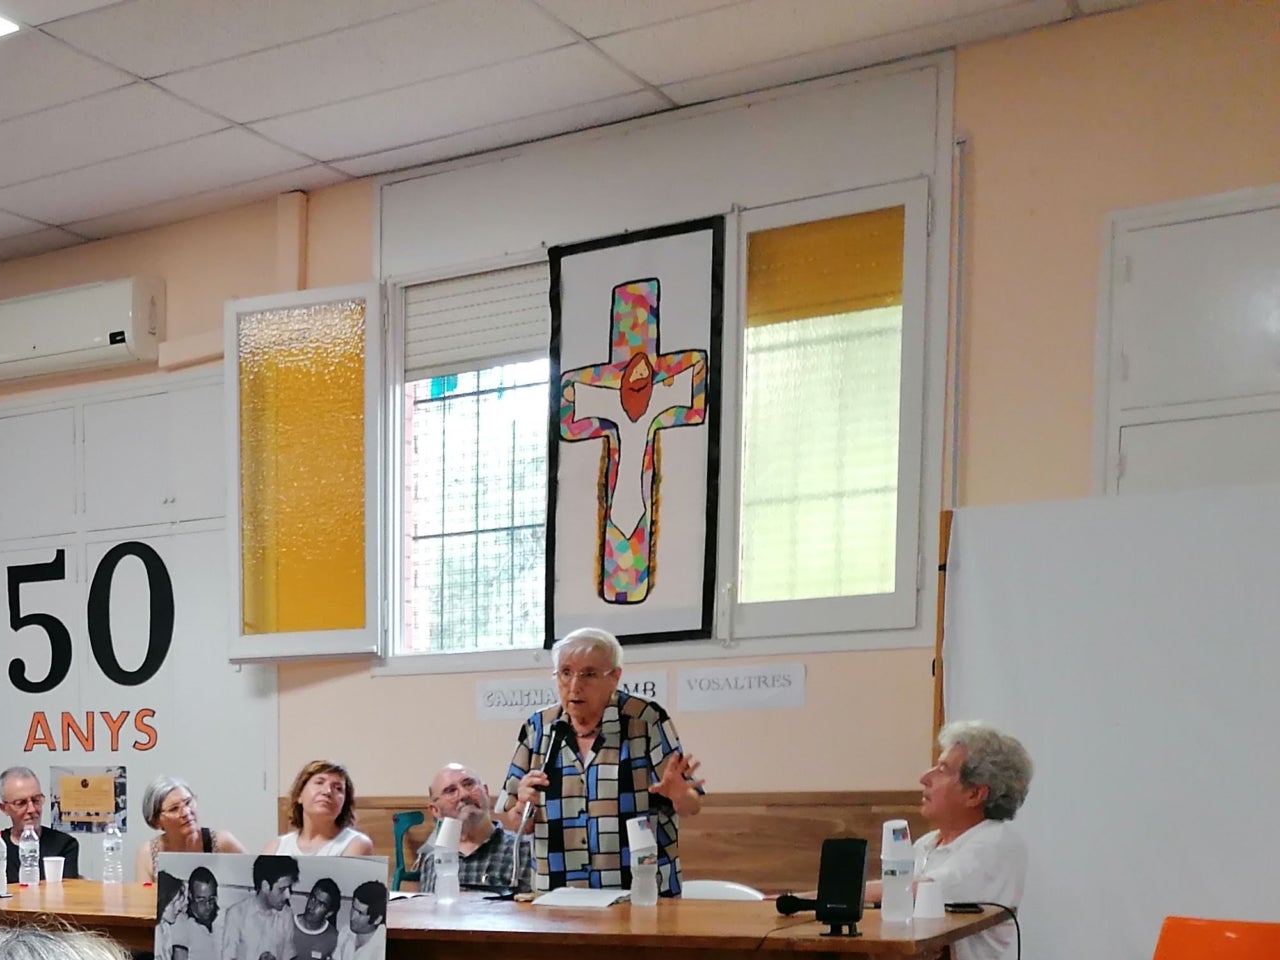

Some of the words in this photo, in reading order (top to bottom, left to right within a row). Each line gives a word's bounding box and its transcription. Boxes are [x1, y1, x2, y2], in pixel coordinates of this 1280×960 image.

[7, 540, 175, 694] 50
[623, 681, 655, 697] MB
[686, 674, 793, 692] VOSALTRES
[23, 707, 159, 753] ANYS
